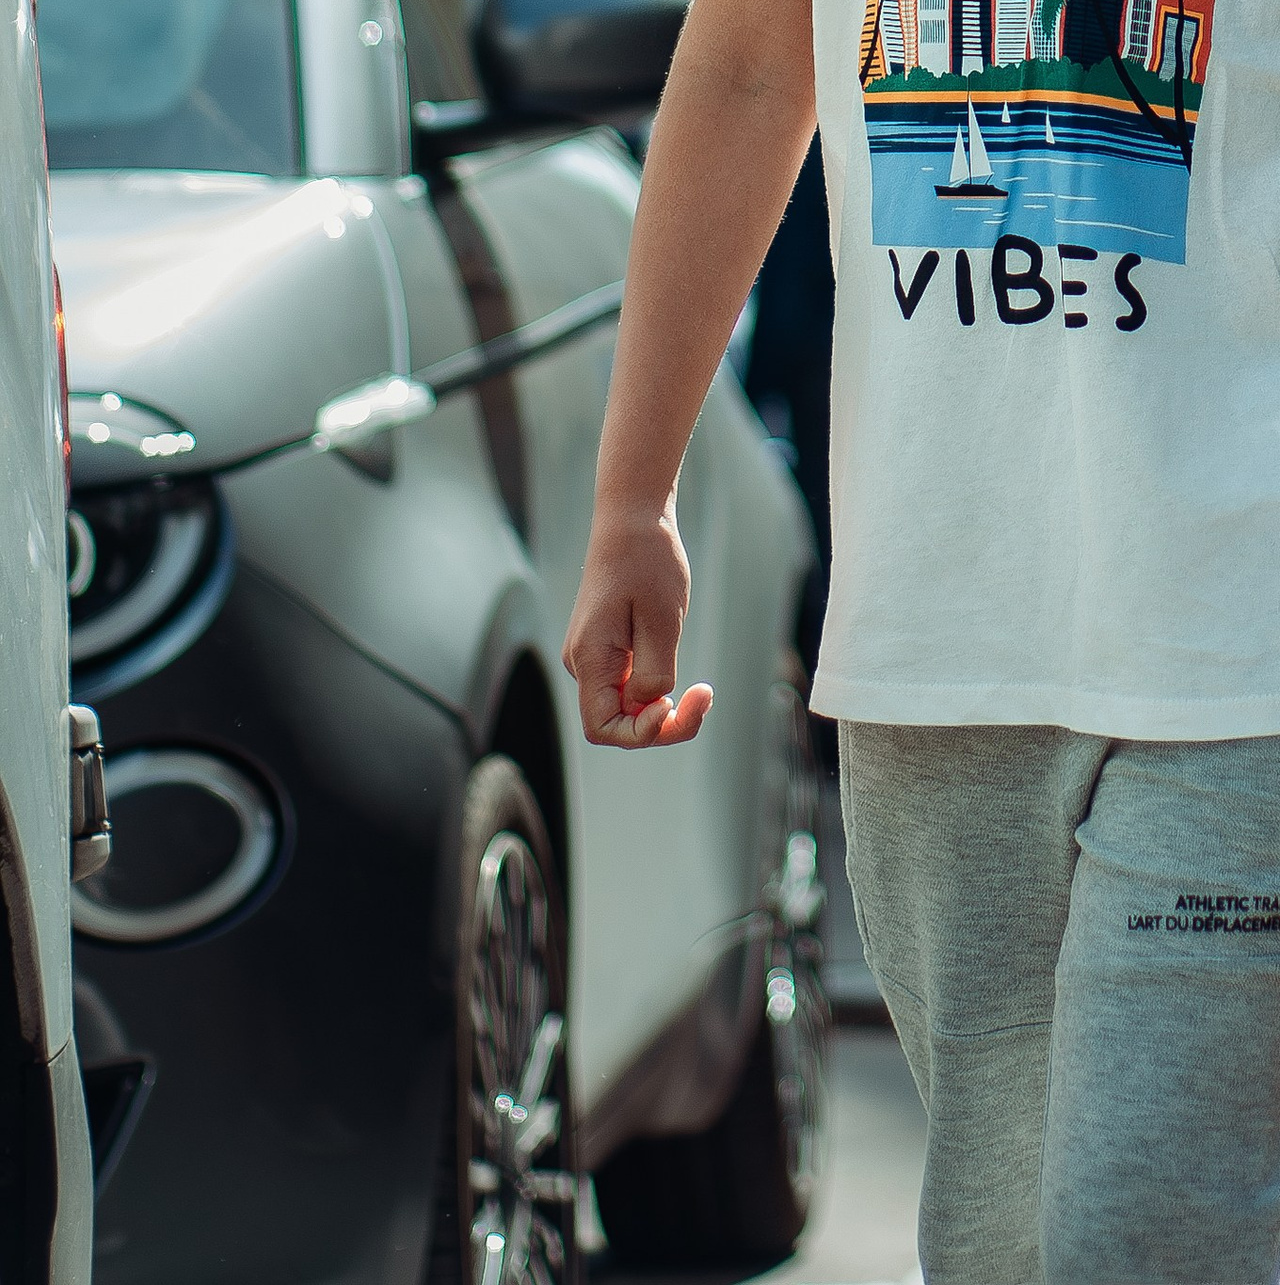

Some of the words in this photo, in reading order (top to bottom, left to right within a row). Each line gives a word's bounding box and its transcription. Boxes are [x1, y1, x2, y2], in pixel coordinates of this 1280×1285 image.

[888, 234, 1147, 332] VIBES
[1175, 895, 1250, 911] ATHLETIC
[1128, 915, 1162, 931] L'ART
[1165, 915, 1189, 931] DU
